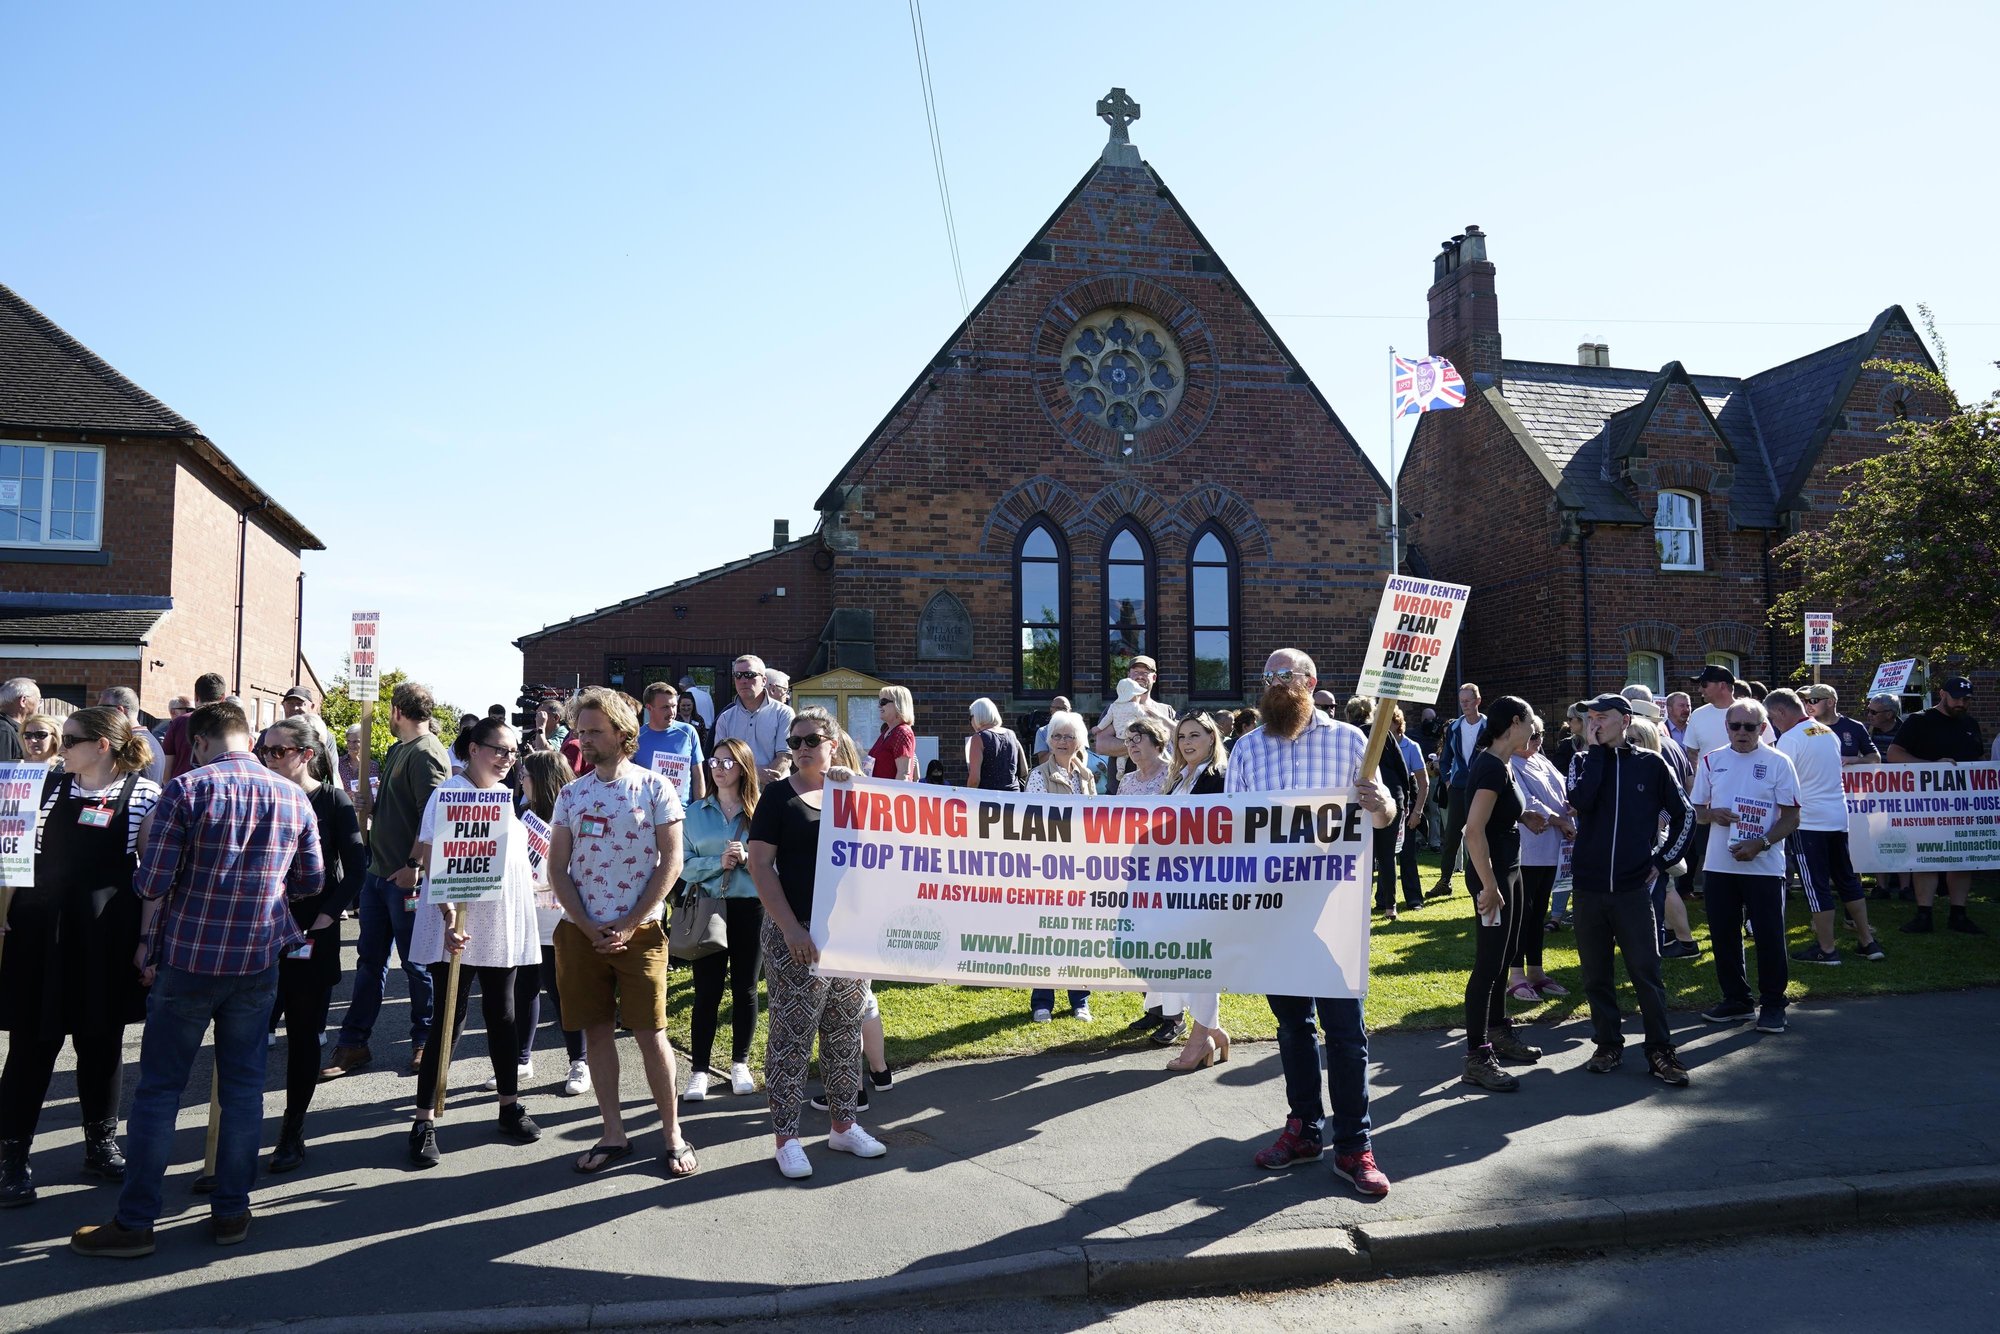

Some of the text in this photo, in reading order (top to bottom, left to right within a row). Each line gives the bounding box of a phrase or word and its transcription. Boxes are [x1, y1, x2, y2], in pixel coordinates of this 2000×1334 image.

[1388, 578, 1468, 600] ASYLUM CENTRE
[1393, 594, 1452, 619] WRONG
[354, 623, 375, 636] WRONG
[926, 626, 963, 634] VILLAGE
[1397, 614, 1438, 635] PLAN
[358, 636, 371, 648] PLAN
[1382, 632, 1442, 656] WRONG
[354, 652, 374, 664] WRONG
[1382, 650, 1431, 672] PLACE
[356, 665, 372, 678] PLACE
[1364, 668, 1439, 684] www.lintonaction.co.uk
[1882, 664, 1908, 673] WRONG
[1878, 675, 1904, 684] WRONG
[658, 760, 684, 770] WRONG
[662, 768, 678, 777] PLAN
[12, 769, 44, 780] CENTRE
[1842, 770, 1915, 793] WRONG
[1920, 770, 1967, 792] PLAN
[439, 791, 512, 802] ASYLUM CENTRE
[1734, 796, 1772, 809] ASYLUM CENTRE
[1878, 798, 1902, 813] THE
[1904, 796, 2000, 812] LINTON-ON-OUSE
[446, 805, 500, 822] WRONG
[832, 788, 968, 838] WRONG
[978, 800, 1073, 844] PLAN
[1082, 805, 1233, 845] WRONG
[1244, 802, 1362, 844] PLACE
[1738, 804, 1767, 816] WRONG
[524, 812, 546, 836] ASYLUM
[1742, 813, 1760, 824] PLAN
[1892, 818, 1902, 827] AN
[1904, 816, 1936, 826] ASYLUM
[1936, 816, 1965, 826] CENTRE
[1966, 816, 1976, 826] OF
[1976, 815, 1994, 825] 1500
[0, 819, 26, 836] ONG
[454, 822, 490, 838] PLAN
[1736, 822, 1764, 834] WRONG
[444, 840, 497, 858] WRONG
[446, 857, 490, 874] PLACE
[831, 840, 1356, 883] STOP THE LINTON-ON-OUSE ASYLUM CENTRE
[432, 876, 502, 884] www.lintonaction.co.uk
[917, 882, 1283, 910] AN ASYLUM CENTRE OF 1500 IN A VILLAGE OF 700
[1038, 916, 1134, 932] READ THE FACTS:
[886, 928, 942, 940] LINTON ON OUSE
[887, 939, 939, 950] ACTION GROUP
[960, 932, 1213, 960] www.lintonaction.co.uk
[957, 960, 1212, 980] #LintonOnOuse #WrongPlanWrongPlace
